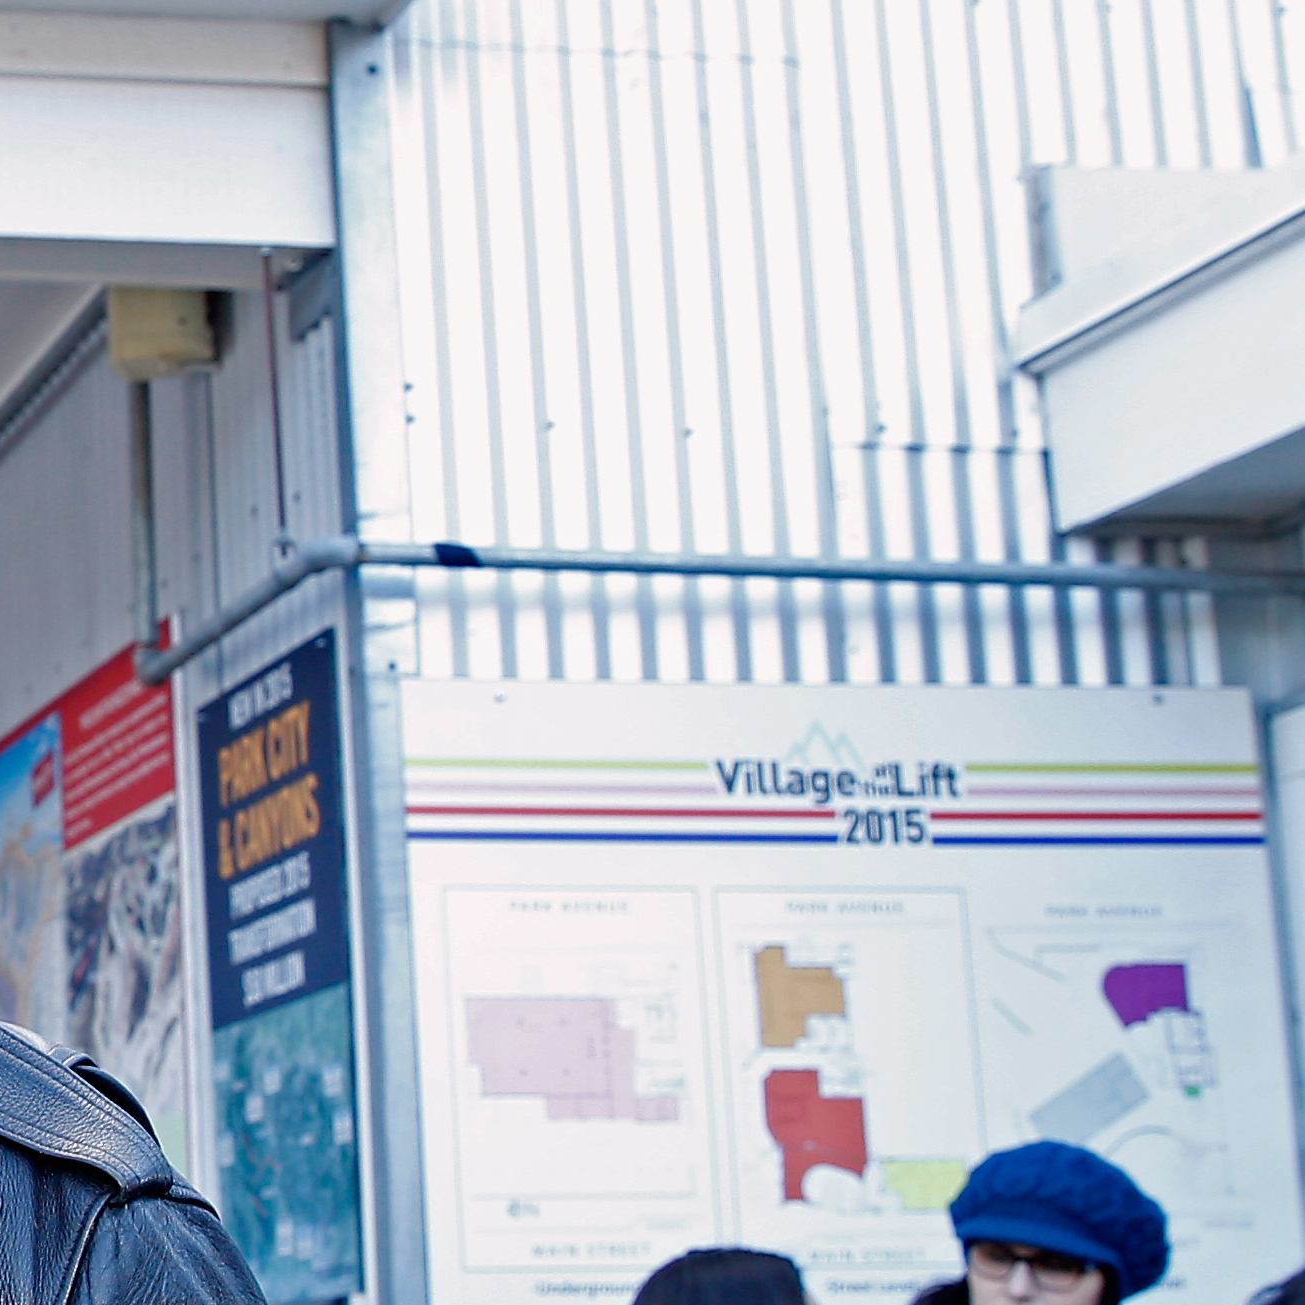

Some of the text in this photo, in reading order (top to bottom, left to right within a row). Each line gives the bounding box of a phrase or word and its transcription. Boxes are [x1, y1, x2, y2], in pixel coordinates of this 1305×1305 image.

[218, 727, 269, 808] PARK
[267, 700, 312, 781] CITY
[715, 760, 857, 804] Village
[894, 761, 960, 797] Lift
[217, 772, 322, 880] & CANYONS
[844, 808, 924, 843] 2015
